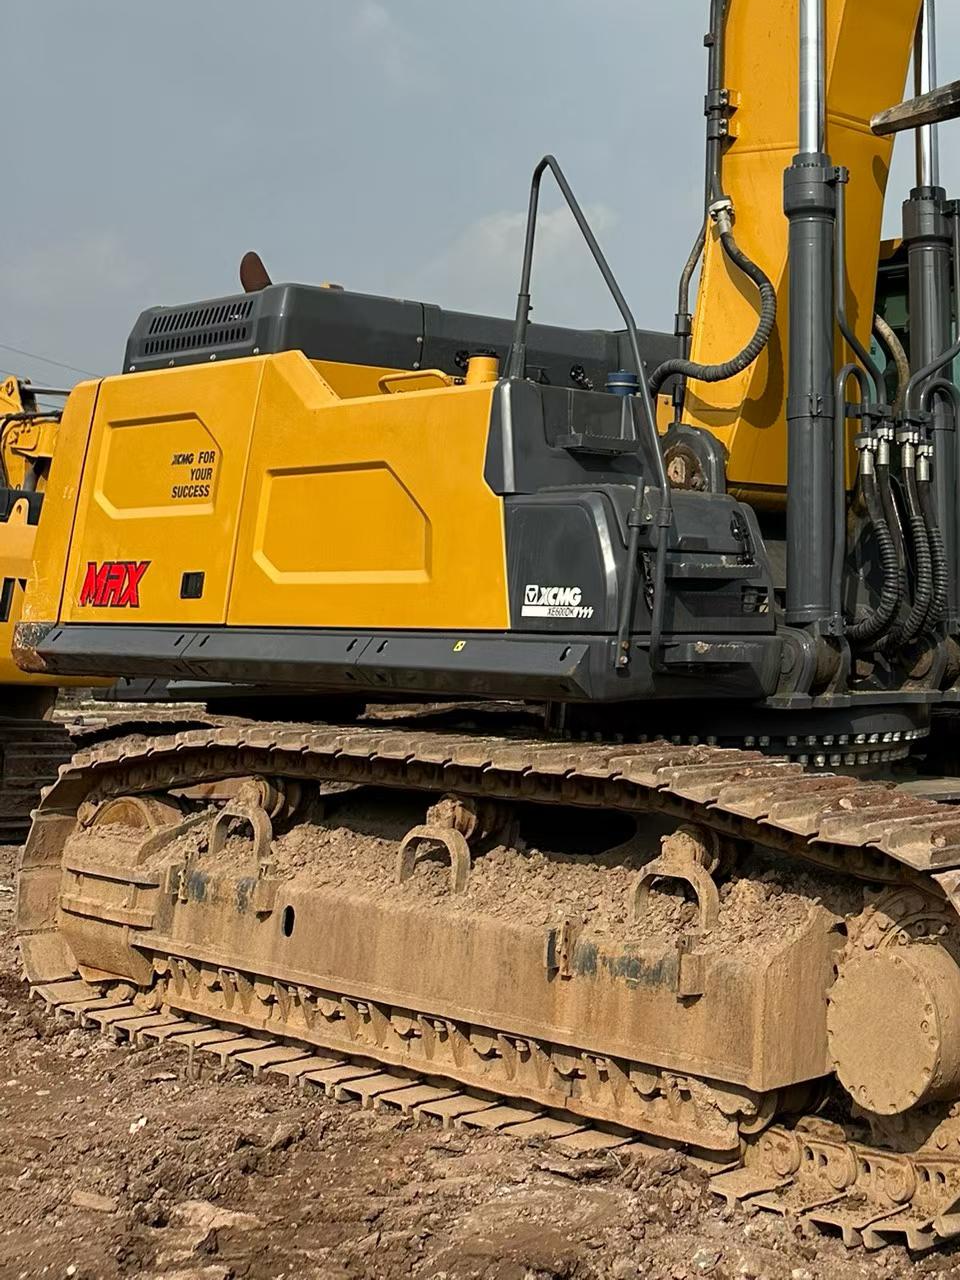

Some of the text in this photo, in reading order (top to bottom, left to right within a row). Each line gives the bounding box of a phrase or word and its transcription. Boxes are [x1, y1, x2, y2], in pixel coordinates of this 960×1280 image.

[171, 451, 215, 465] XCMG FOR
[191, 468, 213, 481] YOUR
[171, 485, 210, 498] SUCCESS
[538, 587, 582, 606] XCMG
